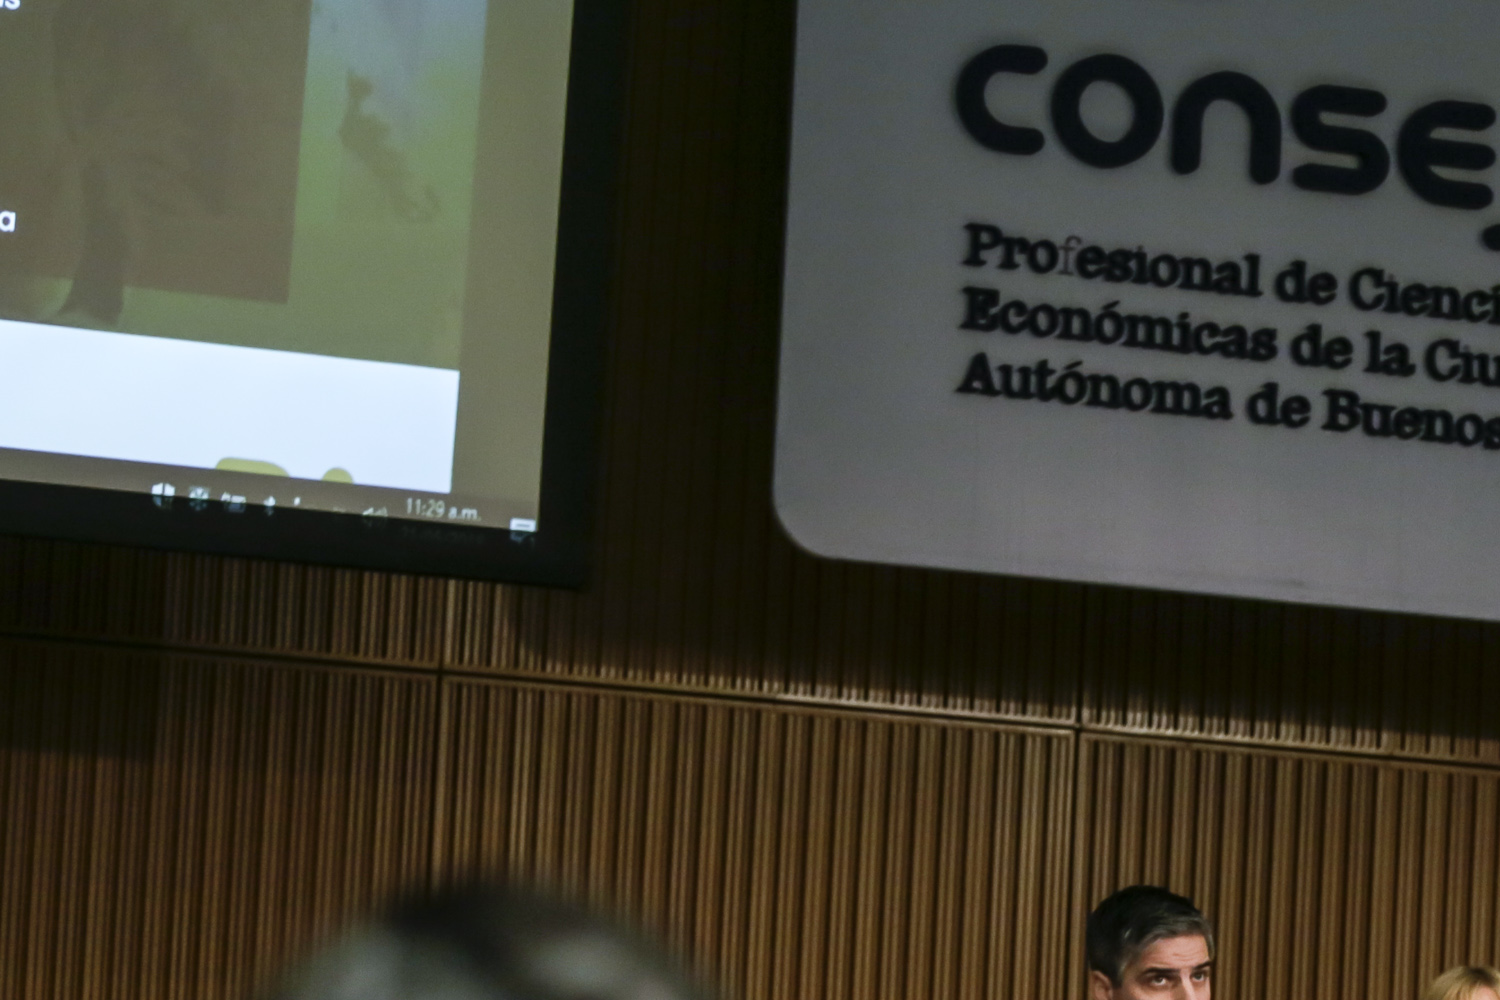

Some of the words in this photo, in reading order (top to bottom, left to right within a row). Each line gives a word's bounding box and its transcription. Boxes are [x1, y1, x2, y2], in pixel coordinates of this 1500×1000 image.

[961, 221, 1264, 298] Profesional
[1274, 259, 1339, 306] de
[959, 285, 1280, 362] Económicas
[1289, 322, 1355, 371] de
[1363, 329, 1417, 379] la
[954, 351, 1235, 421] Autónoma
[1246, 380, 1313, 429] de
[406, 497, 446, 519] 11:29
